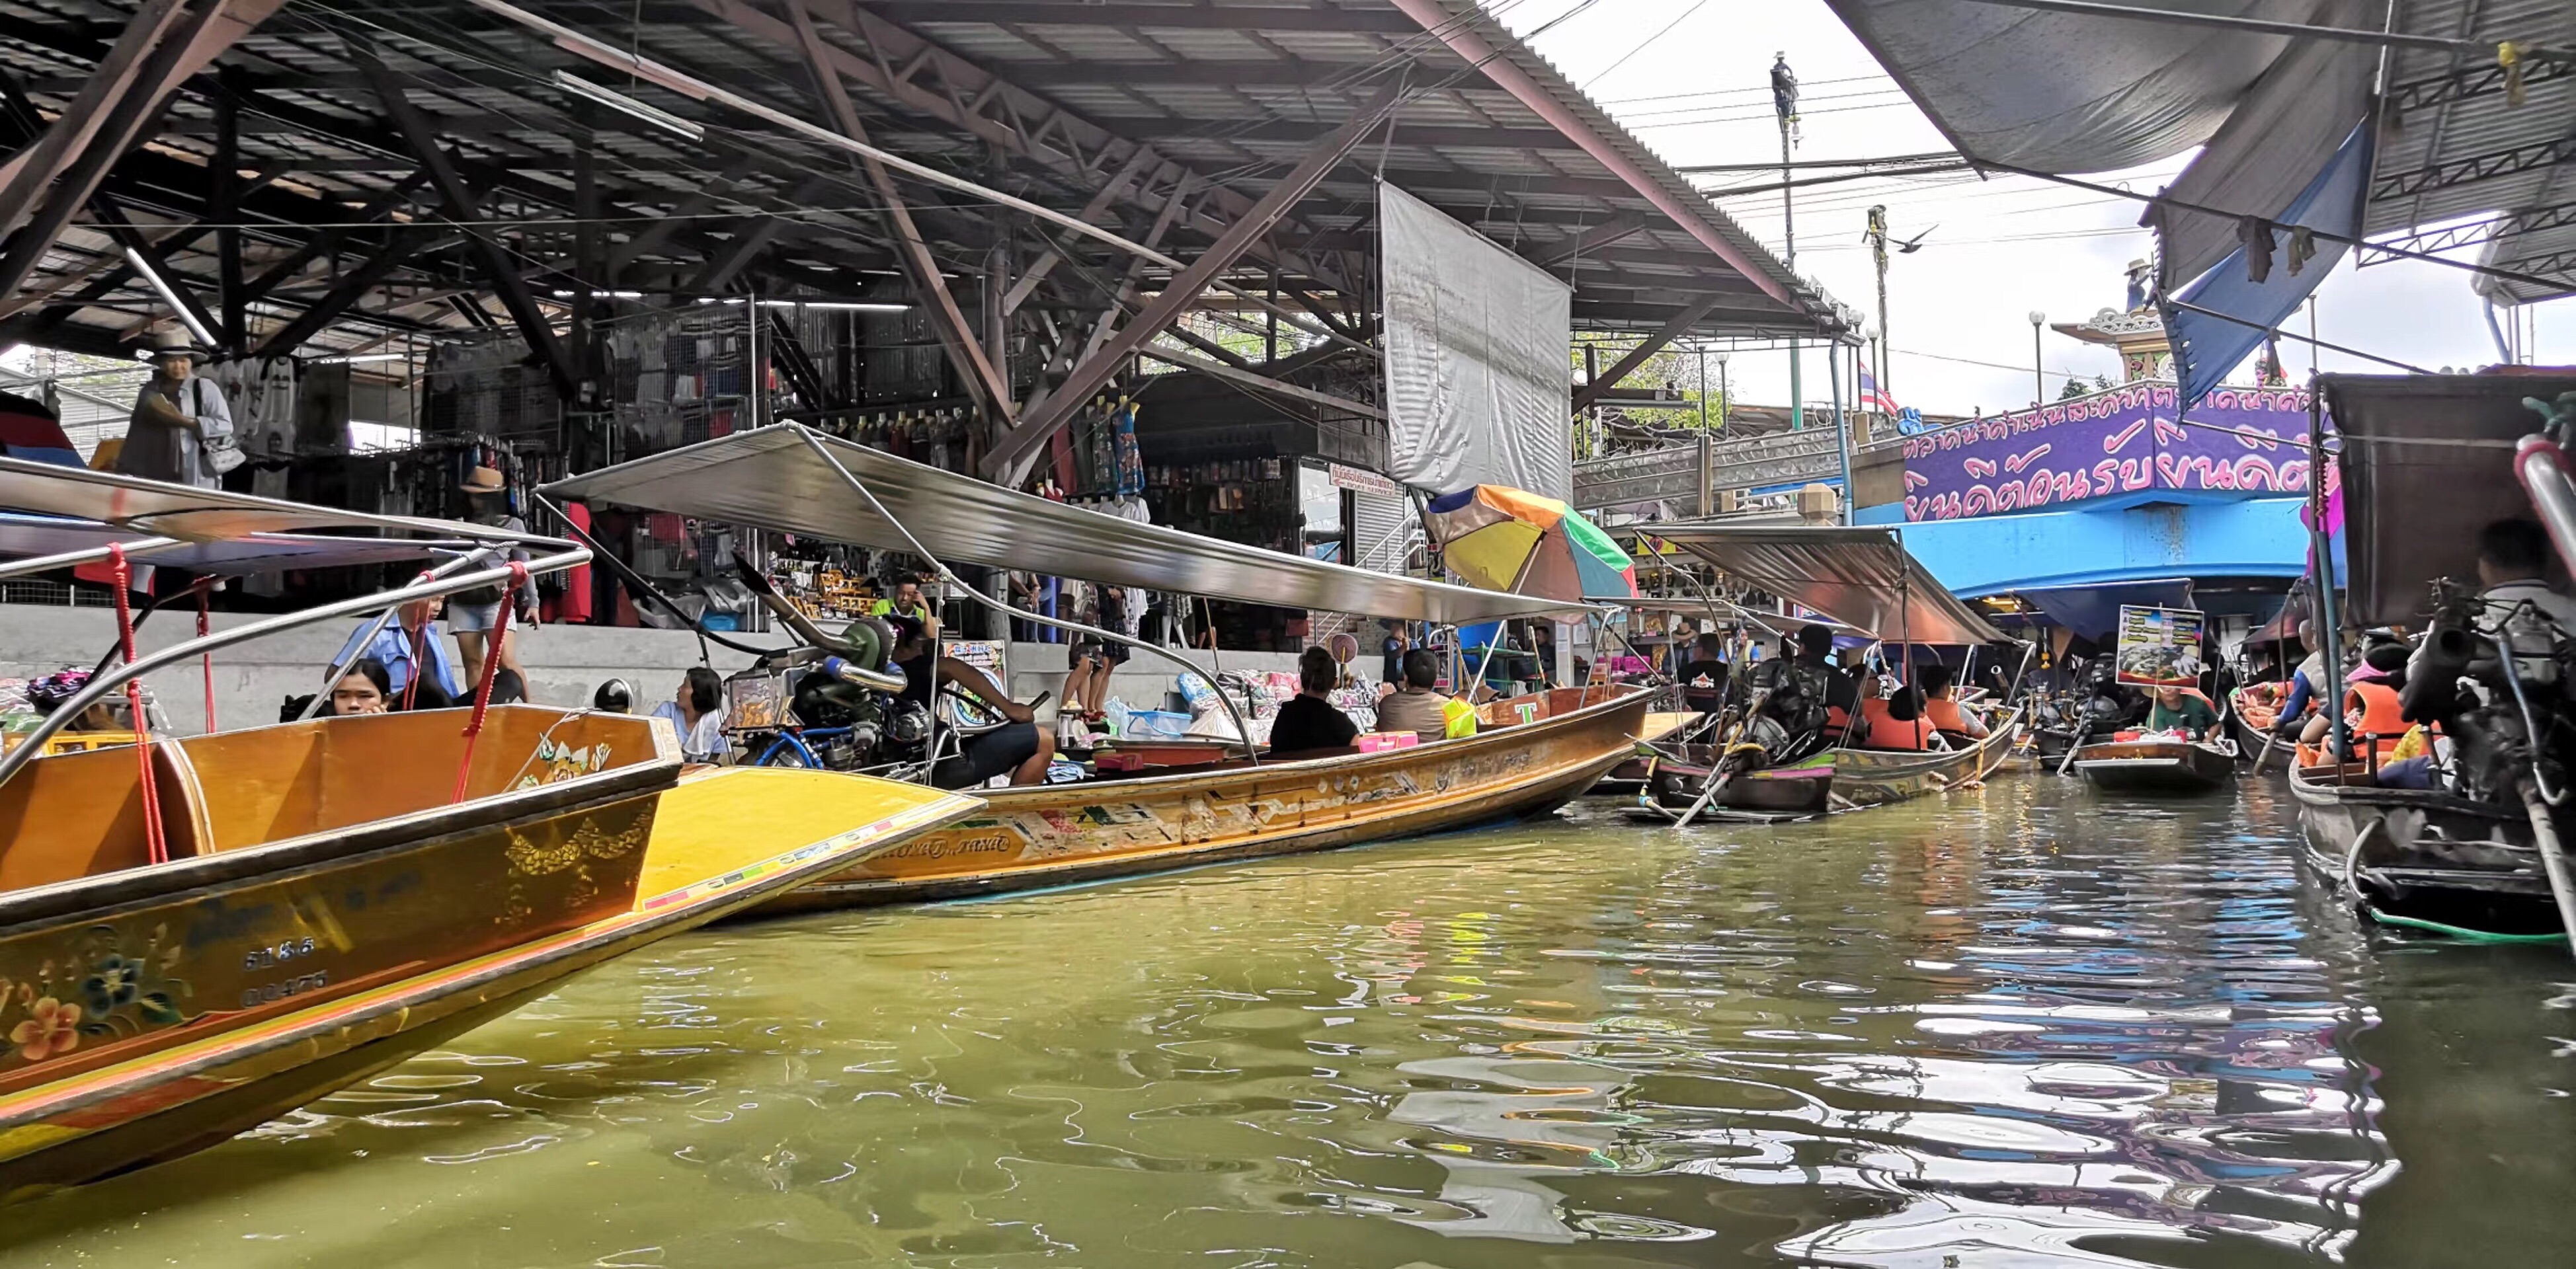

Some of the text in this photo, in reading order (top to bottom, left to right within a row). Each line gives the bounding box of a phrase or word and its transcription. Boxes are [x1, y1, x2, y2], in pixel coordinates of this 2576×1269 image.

[1904, 418, 2153, 522] ยินดีต้อนรับ
